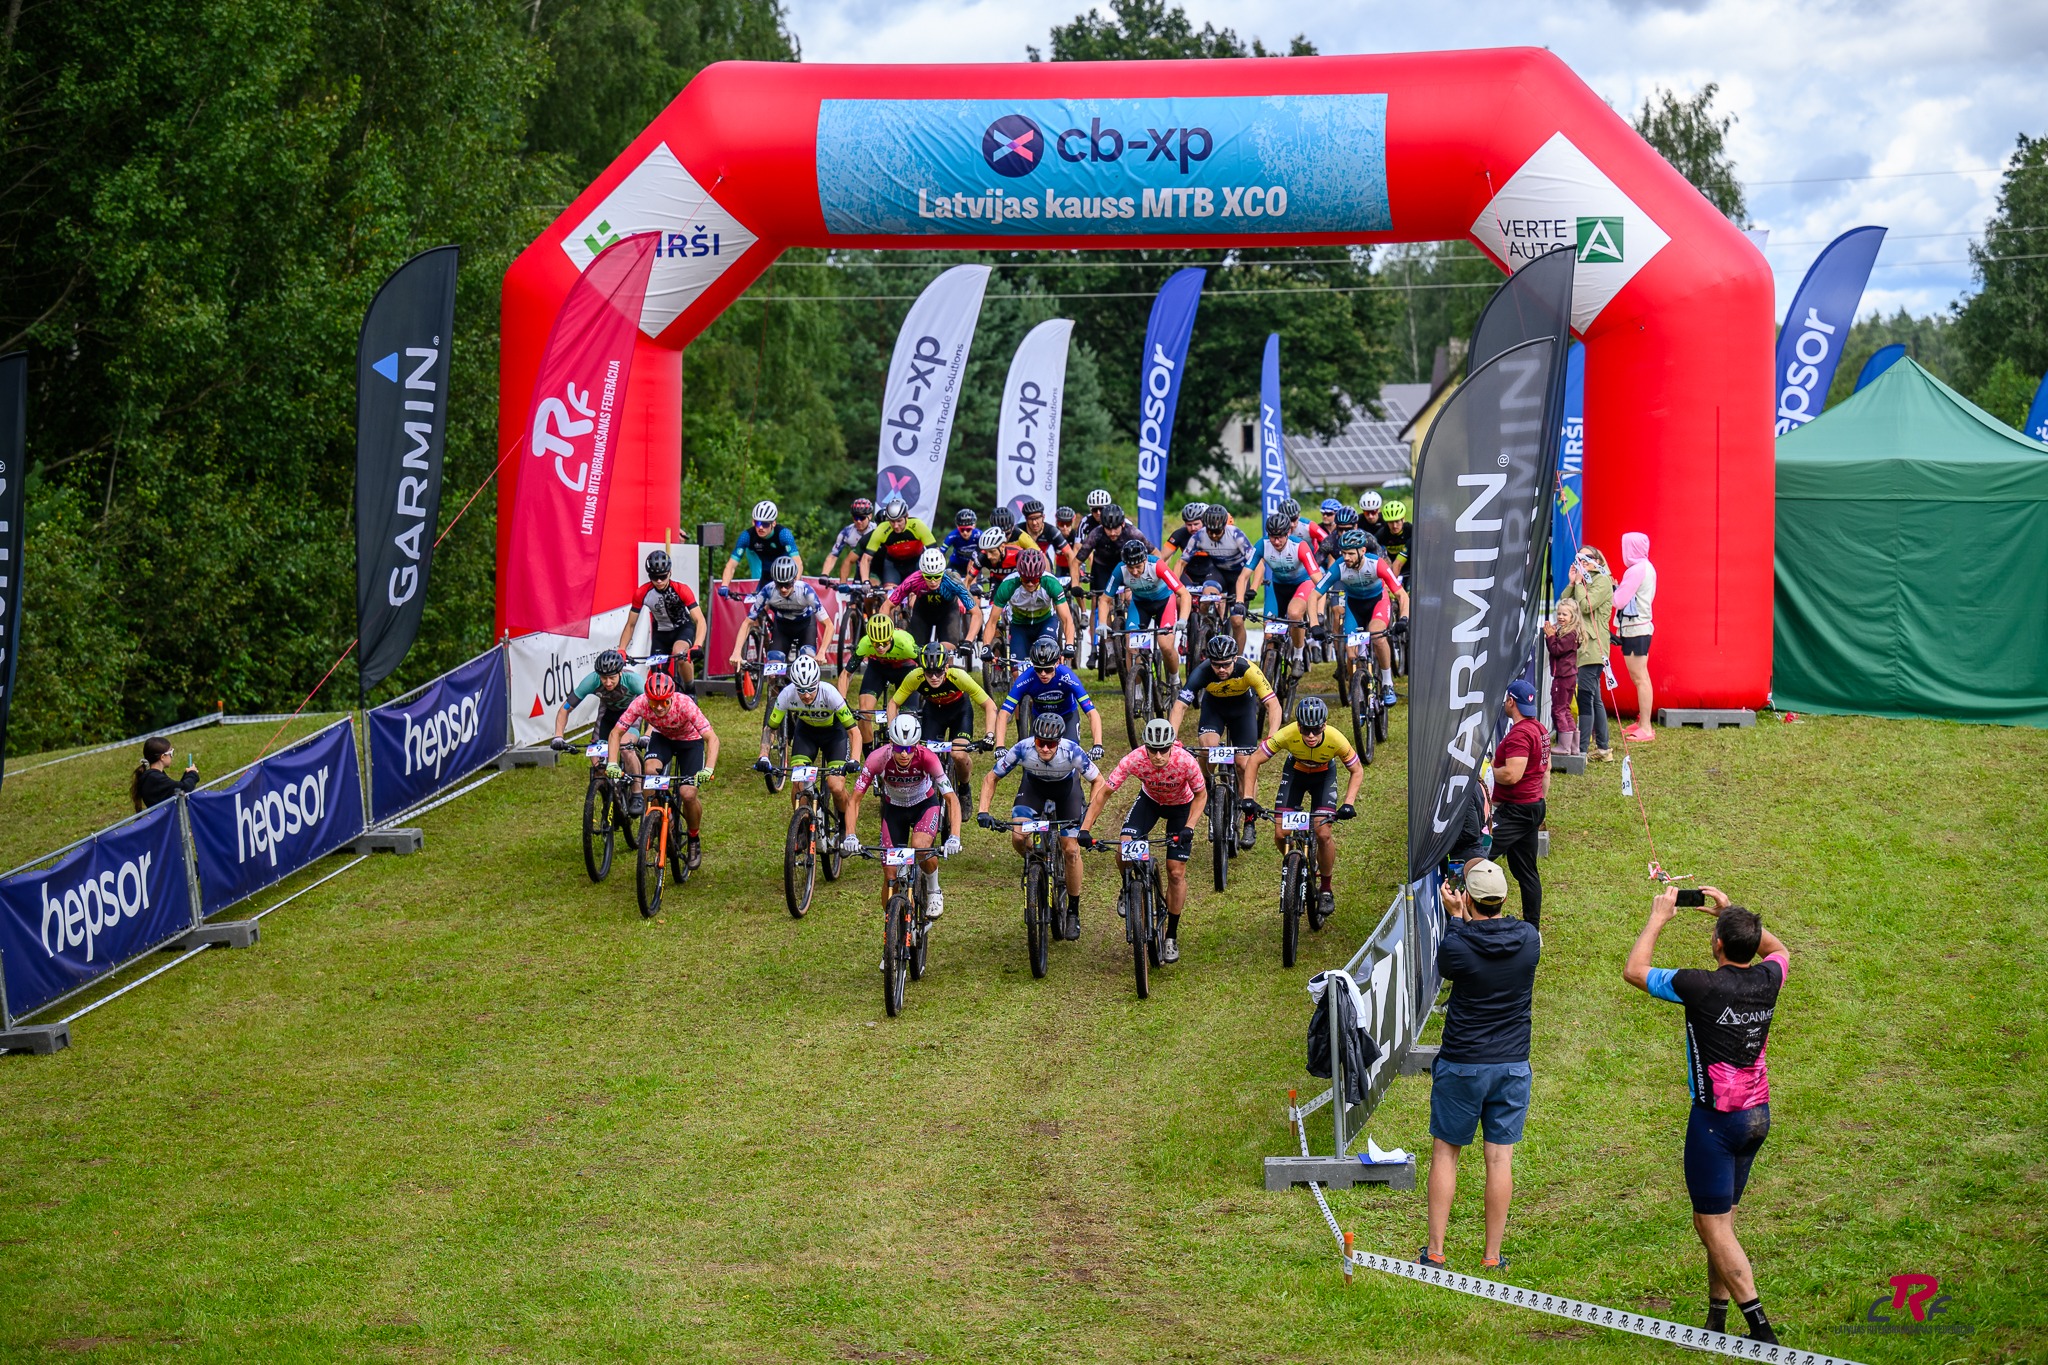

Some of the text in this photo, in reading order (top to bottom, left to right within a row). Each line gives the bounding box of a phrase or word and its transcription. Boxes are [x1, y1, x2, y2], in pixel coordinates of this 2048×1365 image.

[1057, 117, 1213, 175] cb-xp
[918, 186, 1288, 225] Latvijas kauss MTB XCO
[1497, 219, 1568, 239] VERTE
[887, 335, 948, 457] cb-xp
[930, 343, 964, 462] Global Trade Solutions
[580, 360, 620, 535] LATVIJAS RITEŅBRAUKŠANAS FEDERĀCIJA
[1008, 381, 1047, 486] cb-xp
[1045, 387, 1058, 491] Global Trade Solutions
[1561, 417, 1584, 480] VIRŠI
[388, 347, 439, 607] GARMIN
[577, 655, 589, 668] DATA
[1135, 634, 1147, 643] 17
[1432, 472, 1509, 835] GARMIN
[543, 653, 575, 706] dta
[404, 688, 482, 780] hepsor
[1212, 749, 1232, 758] 182
[654, 776, 661, 785] 5
[887, 775, 921, 784] DAKO
[235, 765, 329, 867] hepsor
[1286, 813, 1307, 824] 140
[896, 850, 905, 859] 4
[1124, 843, 1147, 854] 249
[41, 850, 152, 963] hepsor
